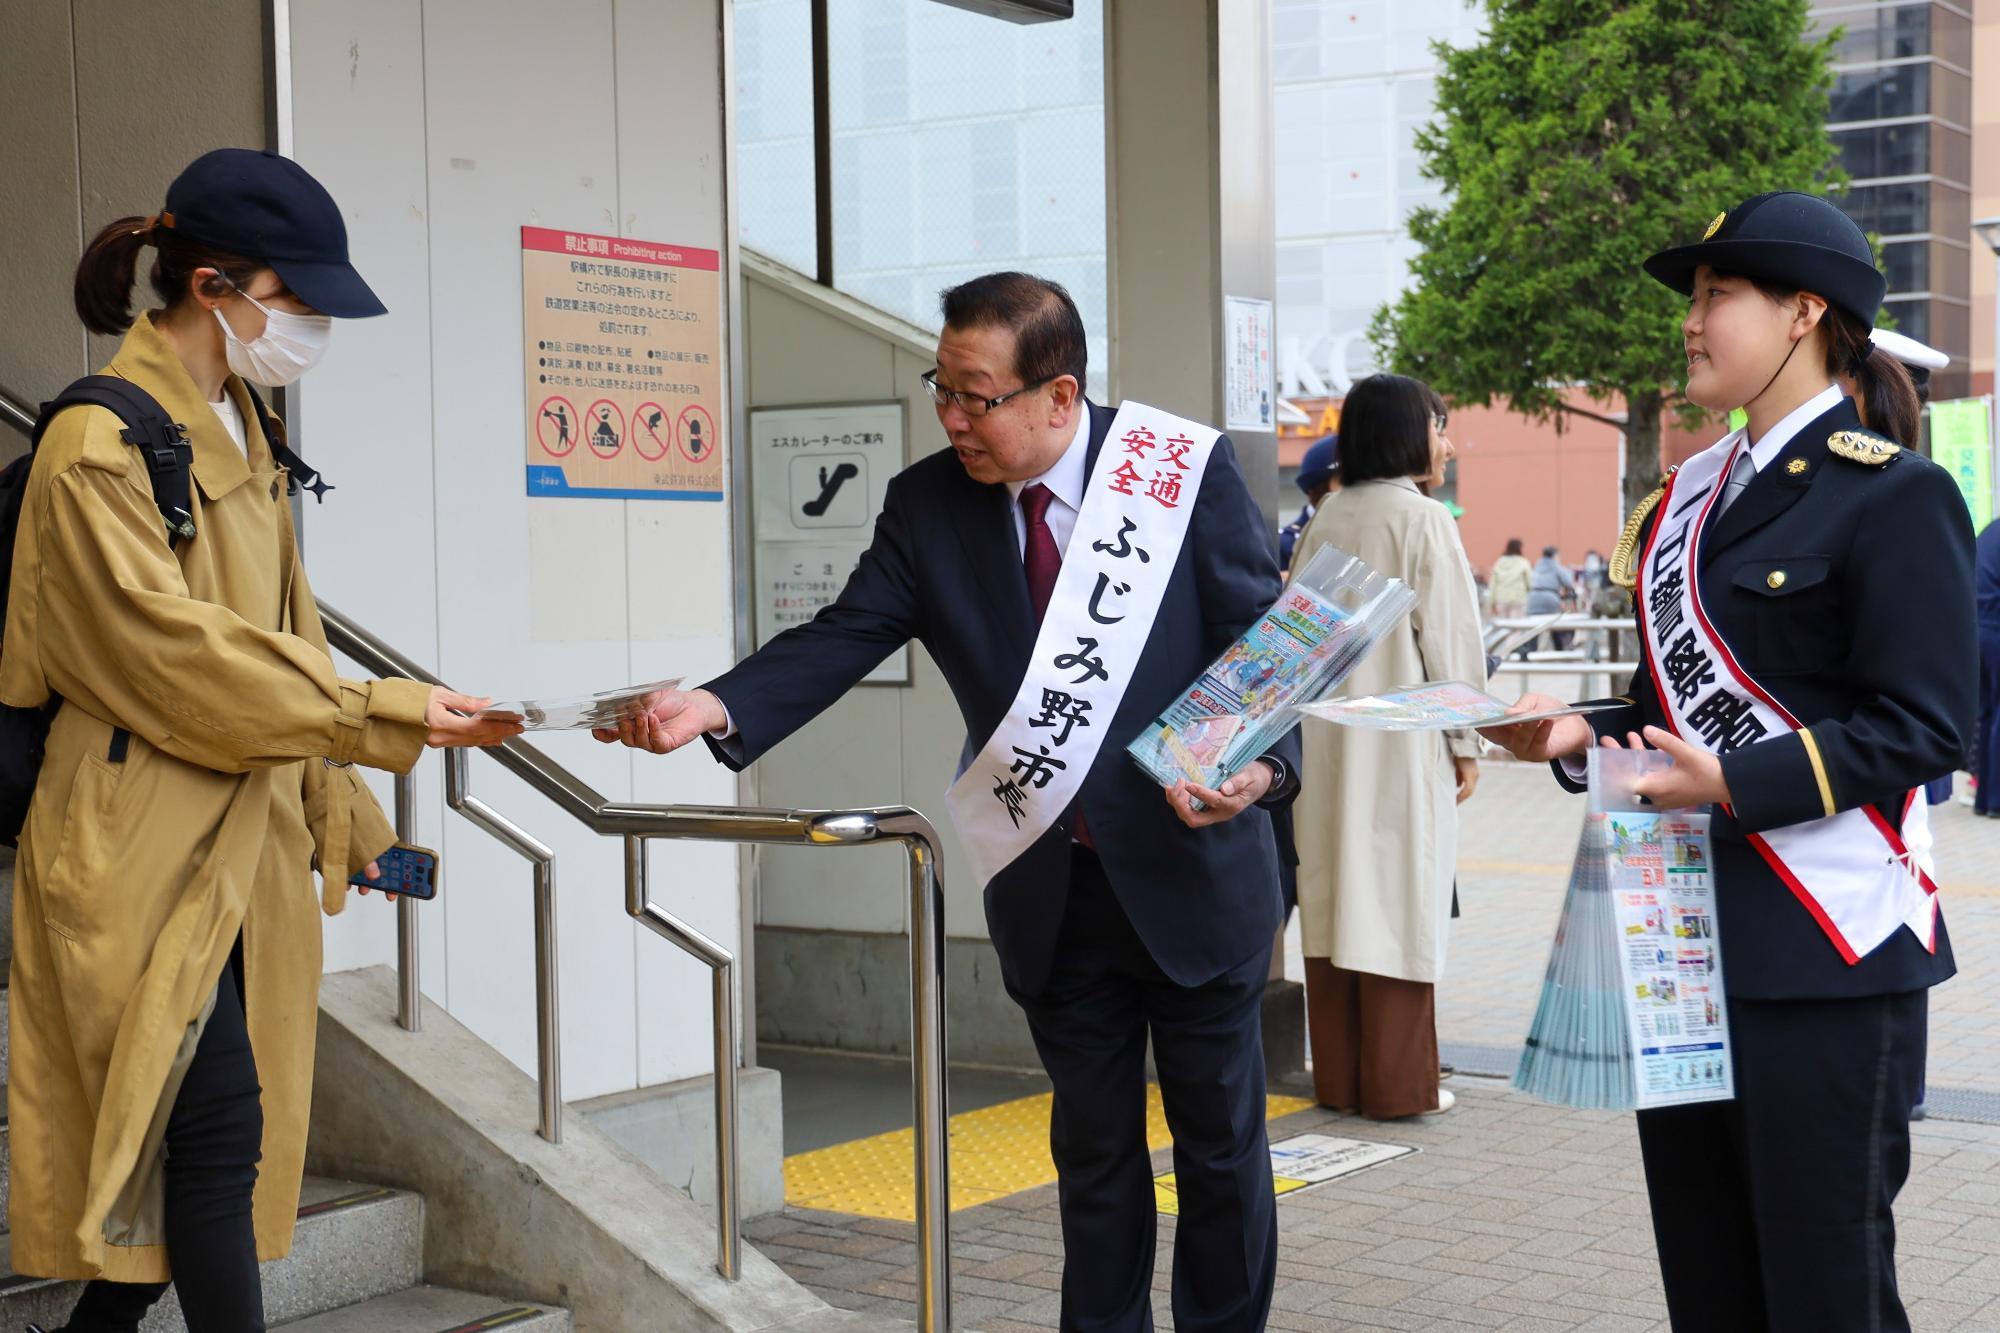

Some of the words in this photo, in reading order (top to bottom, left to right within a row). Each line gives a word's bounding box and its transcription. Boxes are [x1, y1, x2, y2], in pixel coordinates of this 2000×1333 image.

[564, 235, 609, 255] 禁止事項
[613, 243, 657, 260] Prohibiting
[658, 250, 683, 262] action
[570, 261, 678, 284] 駅構内で駅長の承諾を得ずに
[576, 281, 673, 302] これらの行為を行いますと
[771, 431, 884, 448] エスカレーターのご案内
[1106, 425, 1159, 498] 安全
[1143, 432, 1196, 510] 交通
[992, 515, 1151, 830] ふじみ野市長
